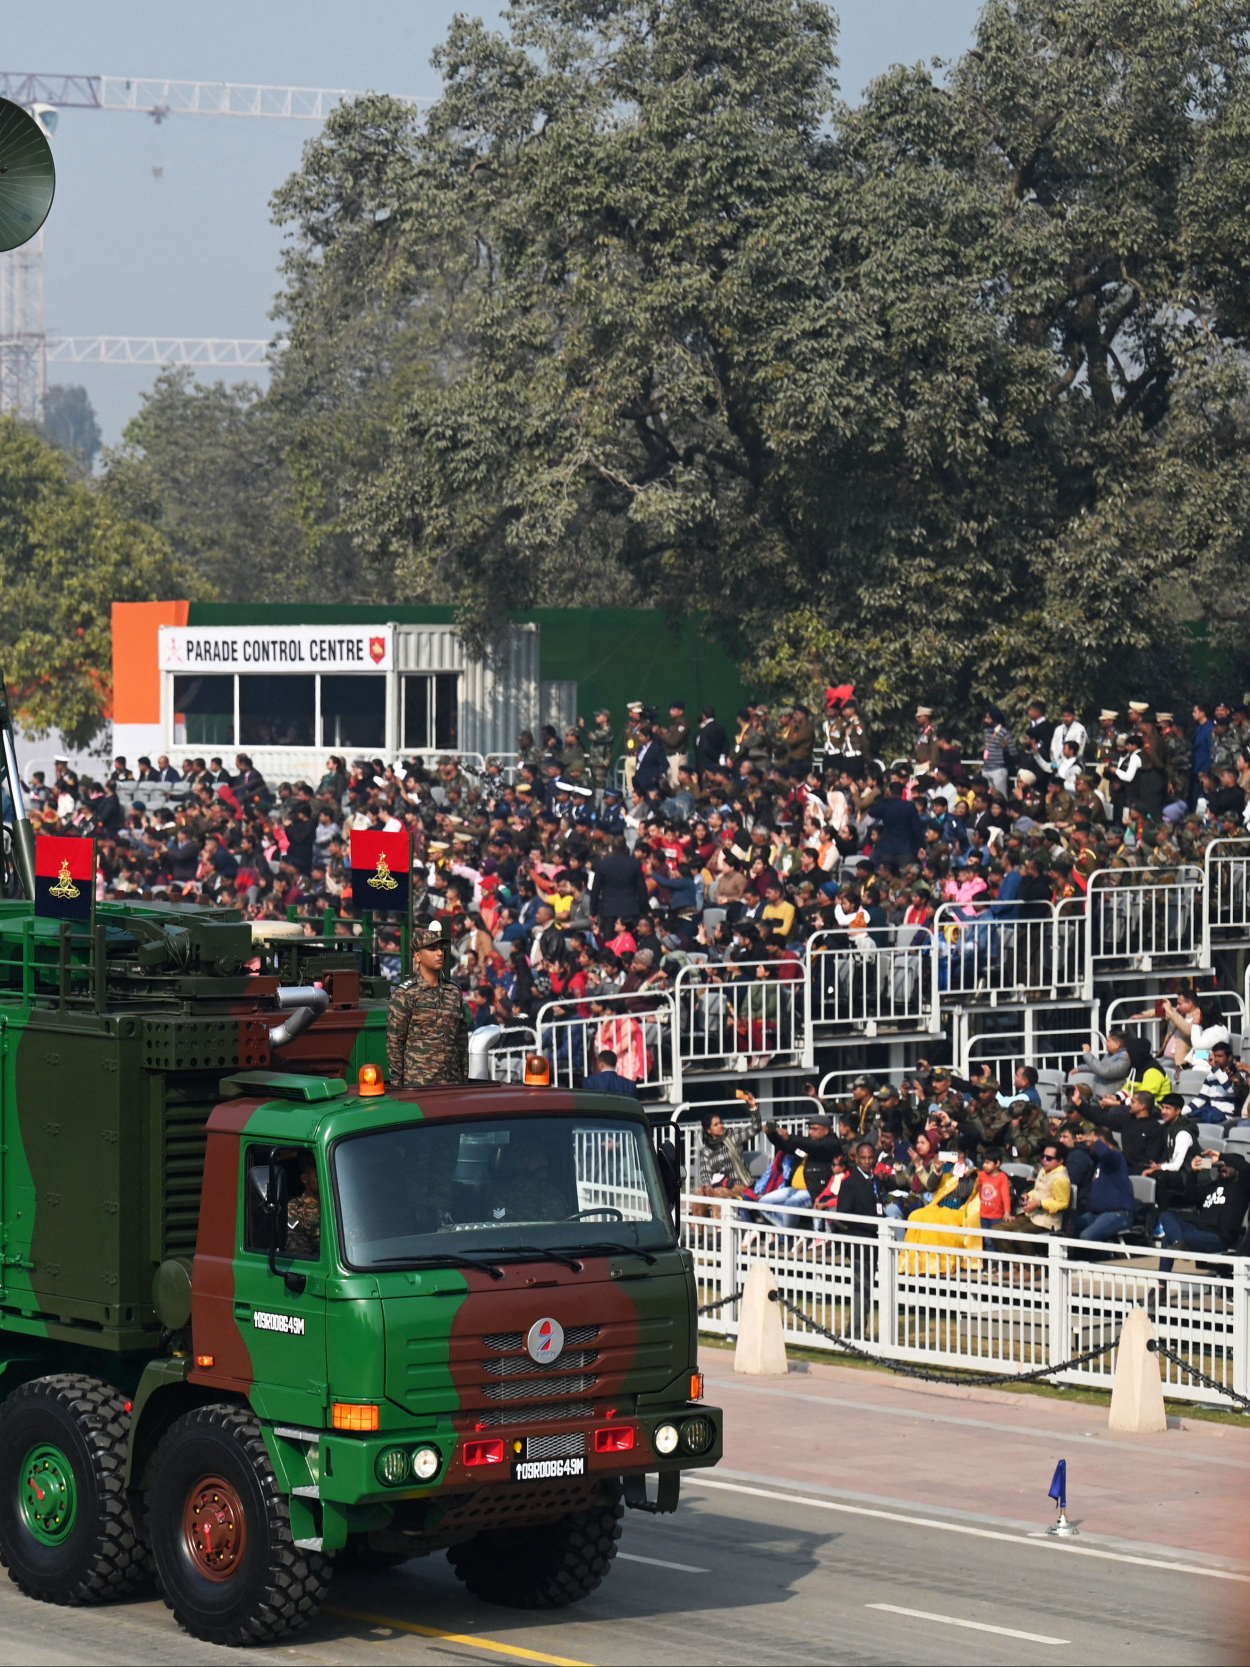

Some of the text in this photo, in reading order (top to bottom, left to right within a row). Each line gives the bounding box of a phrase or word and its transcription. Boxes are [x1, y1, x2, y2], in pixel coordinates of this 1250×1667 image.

[186, 639, 364, 662] PARADE CONTROL CENTRE
